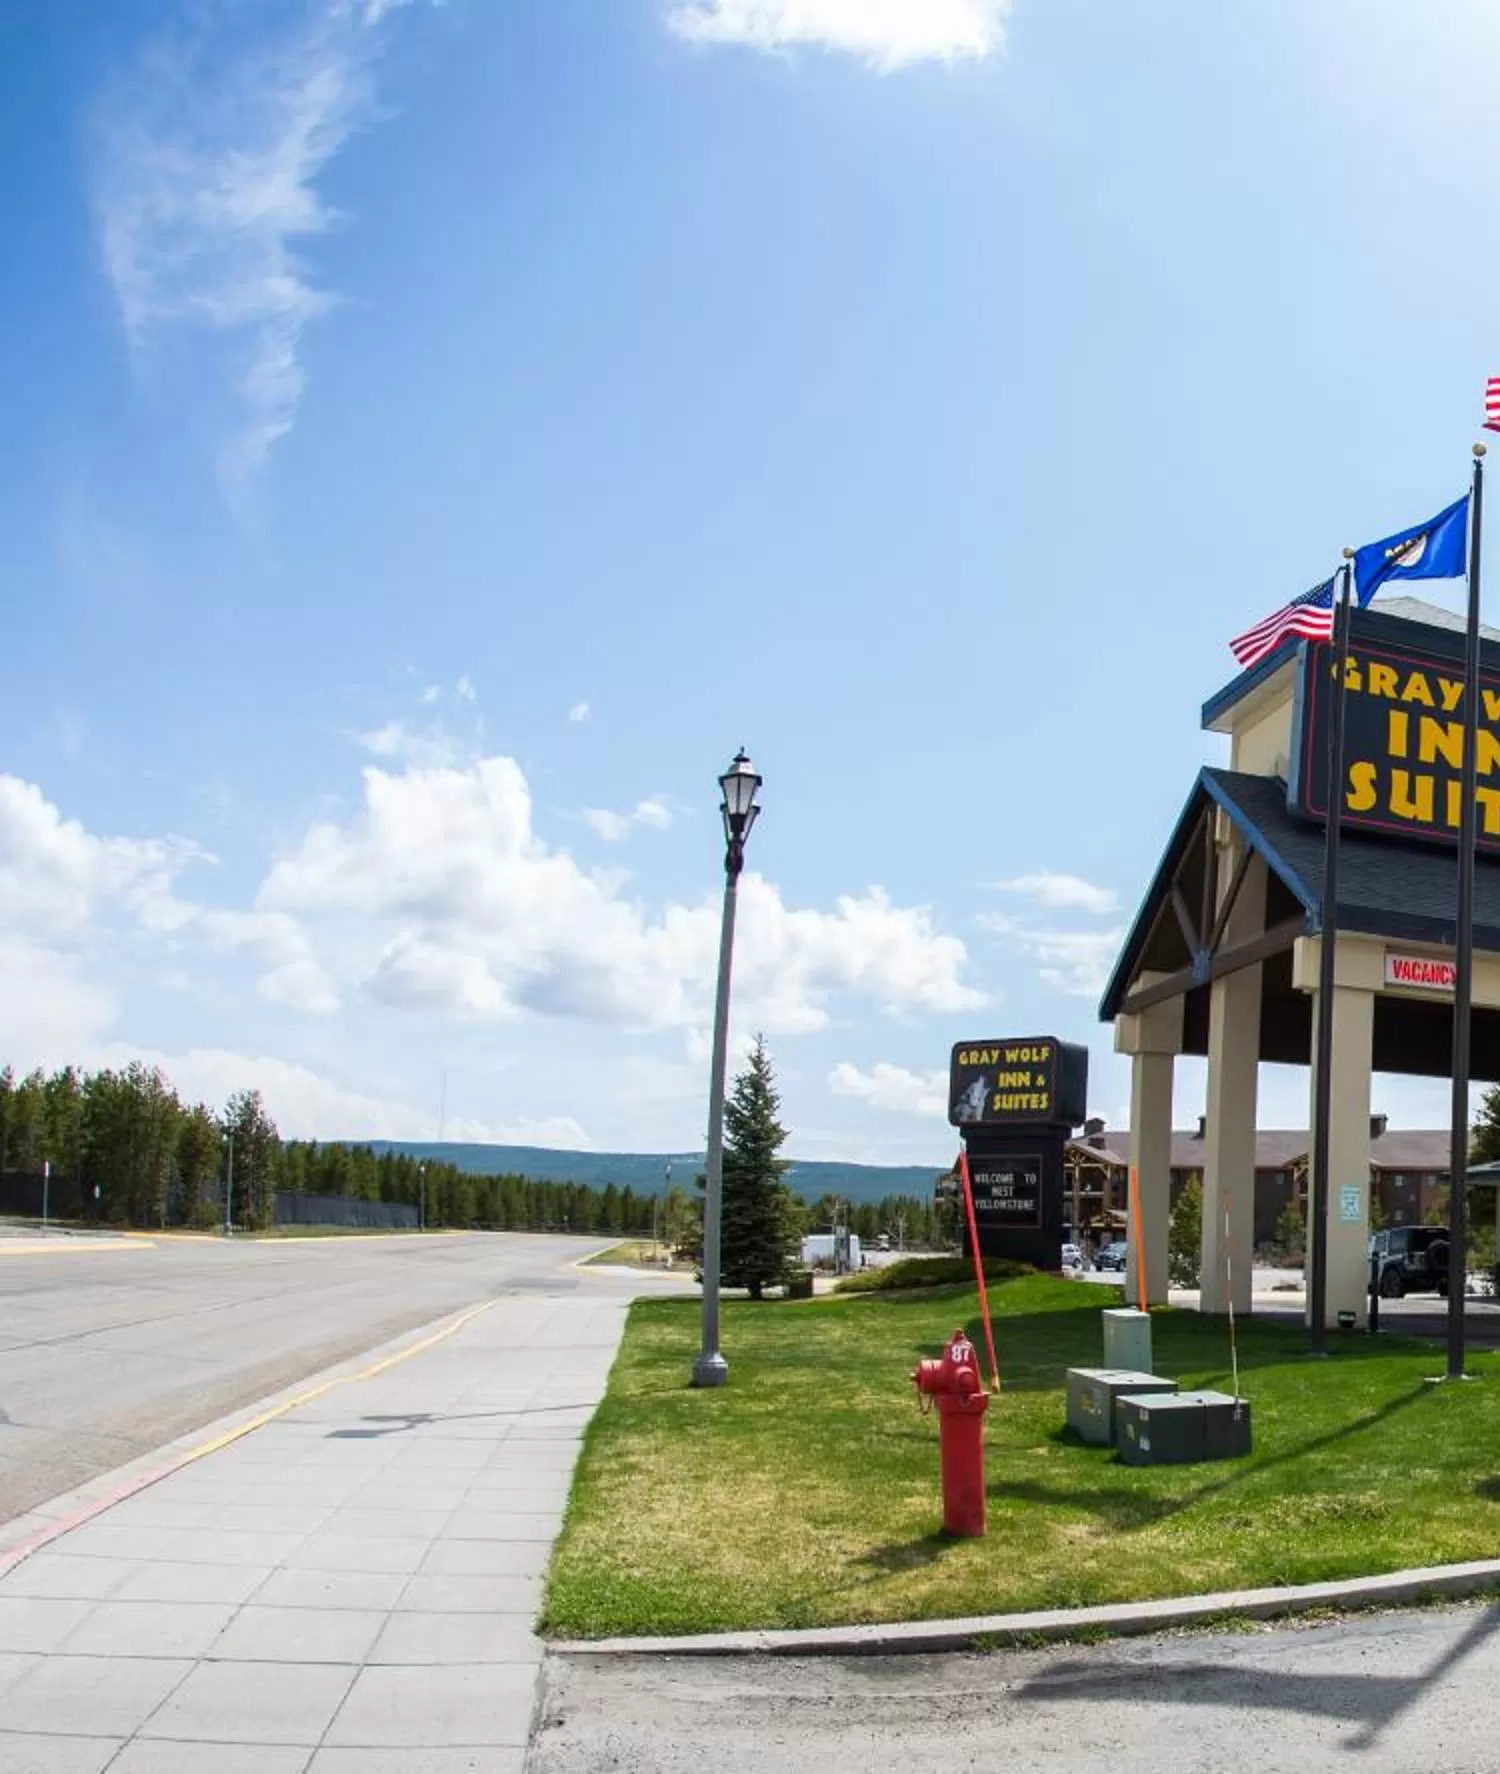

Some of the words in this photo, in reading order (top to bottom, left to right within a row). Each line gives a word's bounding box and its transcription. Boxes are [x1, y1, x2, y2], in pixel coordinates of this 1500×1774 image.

[1331, 656, 1465, 713] GRAY
[959, 1048, 999, 1065] GRAY
[1005, 1046, 1051, 1063] WOLF
[999, 1071, 1031, 1088] INN
[1035, 1074, 1046, 1087] &
[993, 1092, 1049, 1112] SUITES
[974, 1173, 1015, 1184] WELCOME
[1024, 1173, 1037, 1184] TO
[951, 1344, 970, 1362] 87
